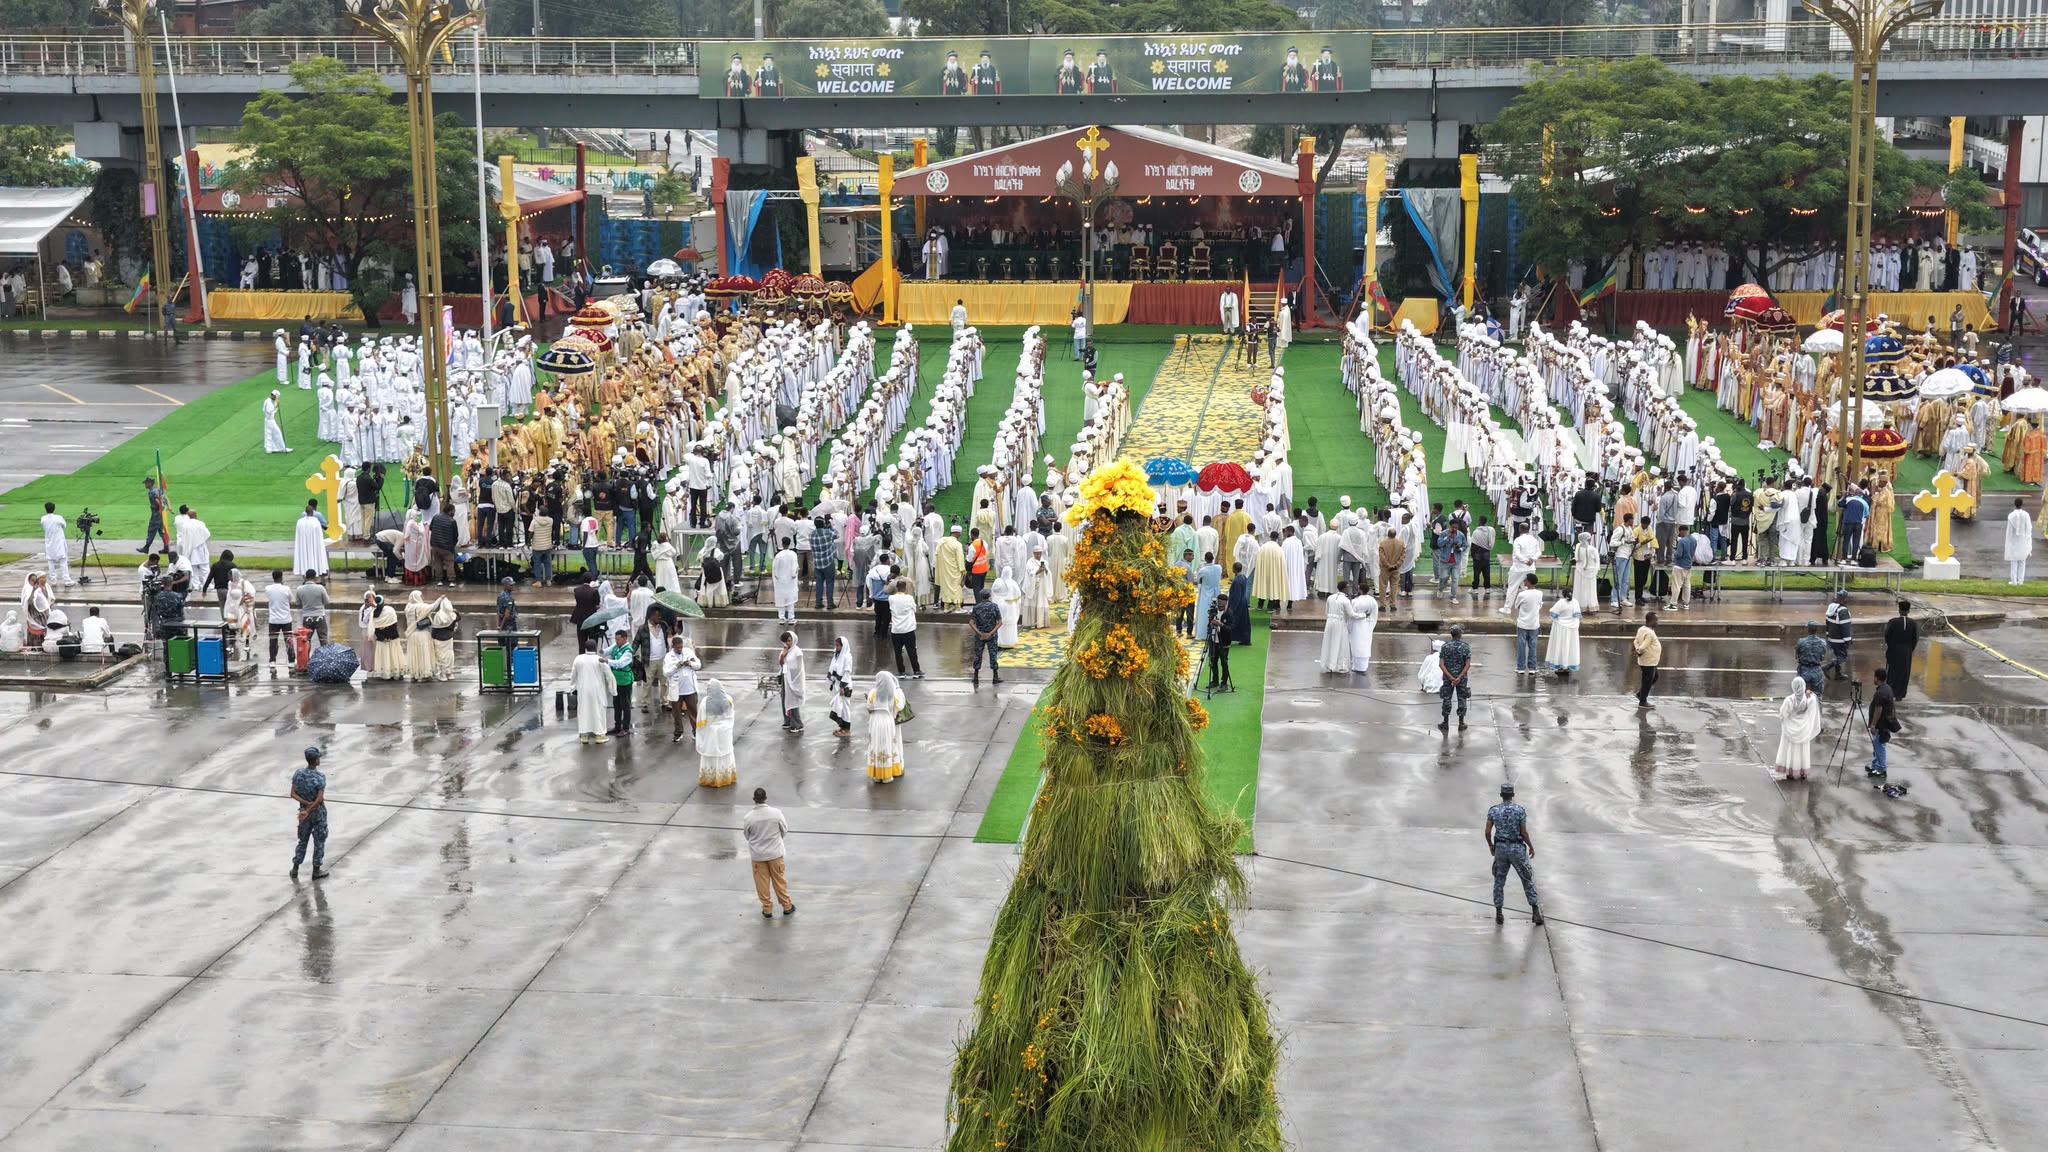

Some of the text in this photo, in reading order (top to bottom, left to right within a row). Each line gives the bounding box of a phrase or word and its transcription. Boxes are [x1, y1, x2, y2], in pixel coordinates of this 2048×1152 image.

[808, 46, 905, 61] እንኳን ደህና መጡ
[1143, 42, 1243, 57] እንኳን ደህና መጡ
[830, 63, 875, 80] स्वागत
[1166, 59, 1212, 77] स्वागत
[816, 80, 896, 94] WELCOME
[1151, 76, 1233, 90] WELCOME
